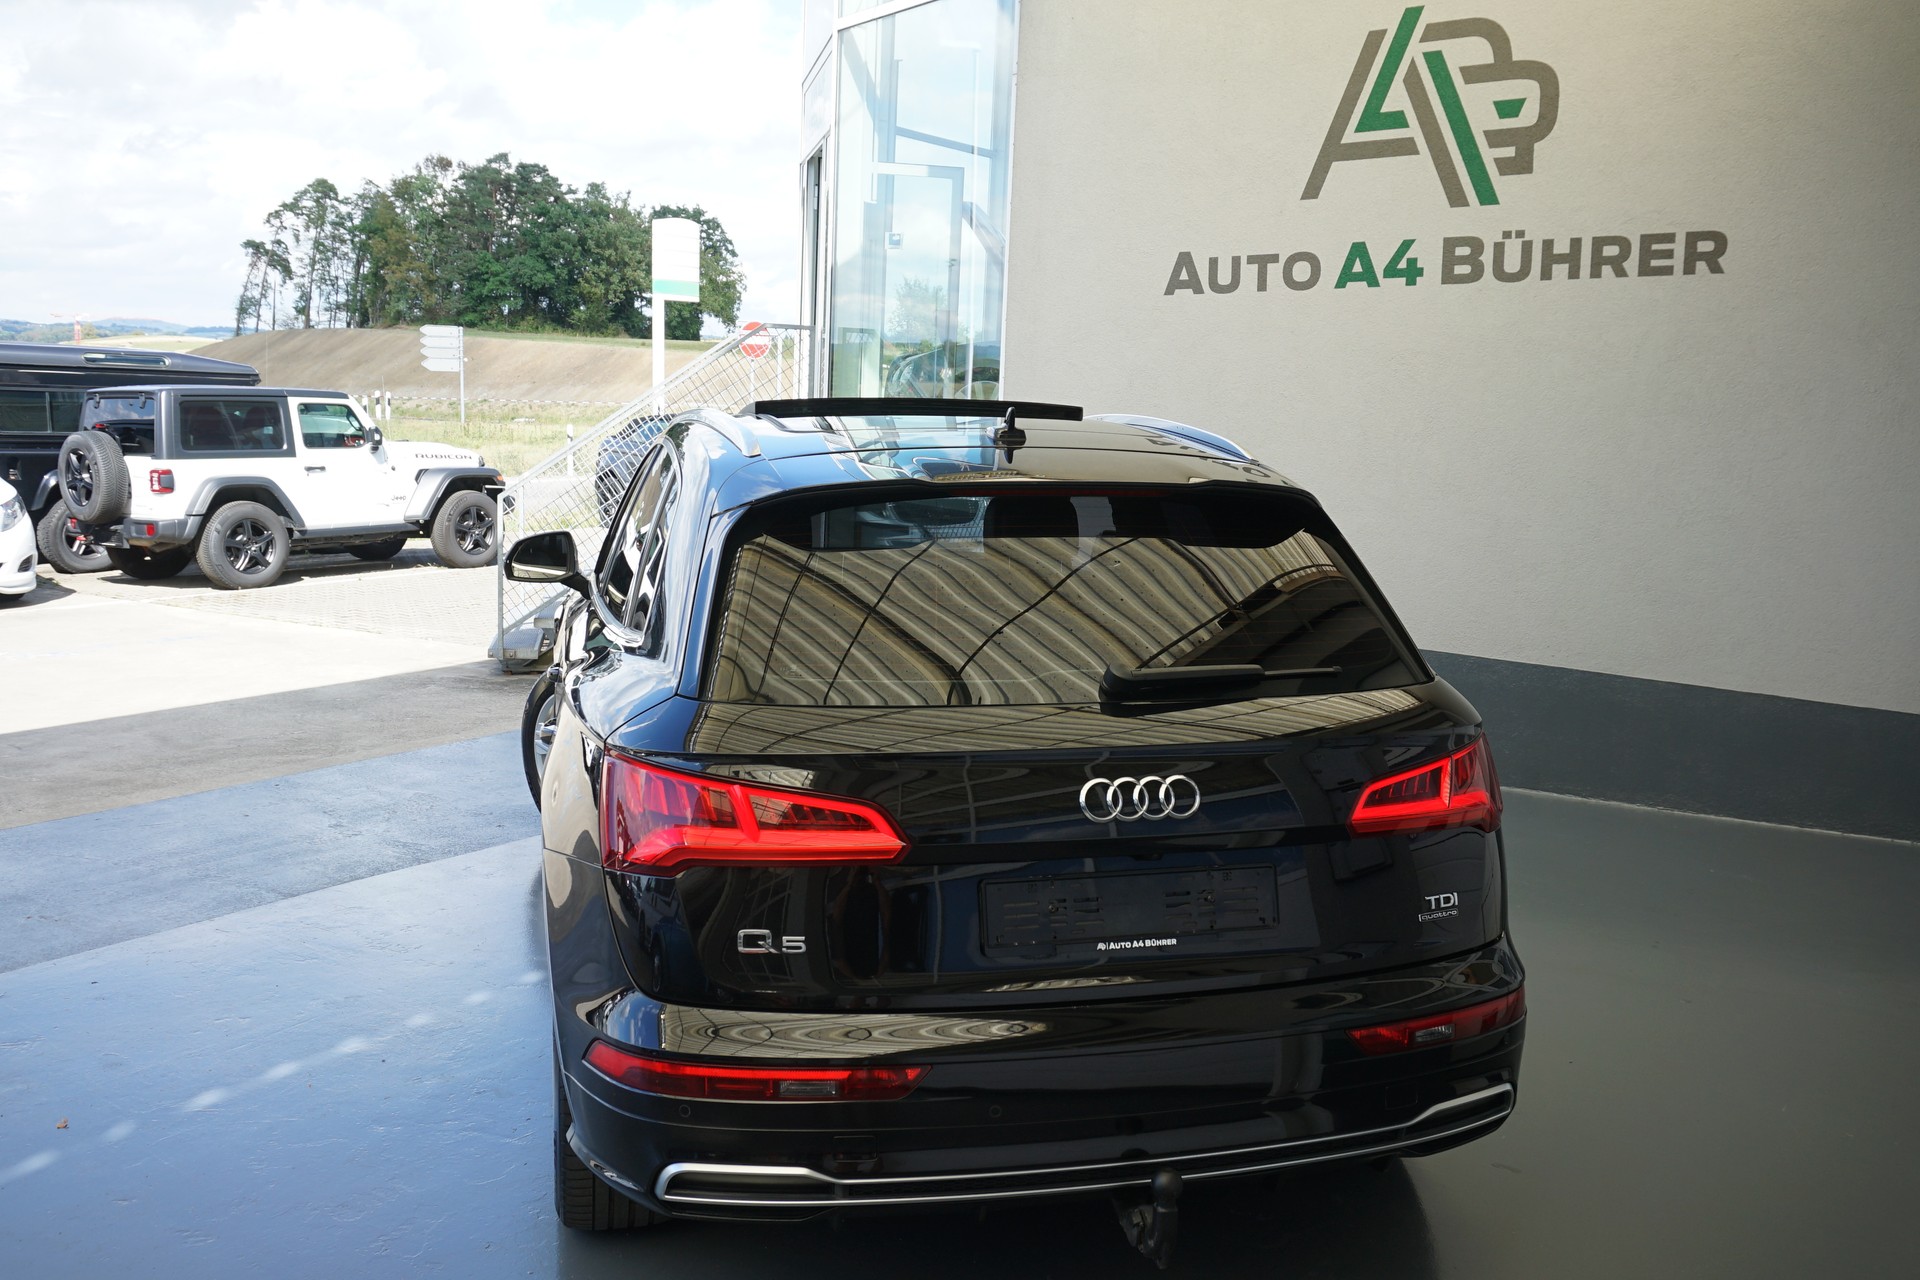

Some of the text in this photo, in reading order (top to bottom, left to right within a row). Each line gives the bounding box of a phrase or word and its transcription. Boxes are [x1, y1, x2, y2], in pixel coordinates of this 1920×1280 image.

[1163, 229, 1729, 296] AUTO A4 BÜHRER
[1424, 892, 1459, 910] TDI
[1420, 910, 1458, 921] quattro
[737, 928, 807, 954] Q5
[1109, 941, 1131, 950] AUTO
[1132, 940, 1144, 948] A4
[1145, 938, 1177, 947] BÜHRER
